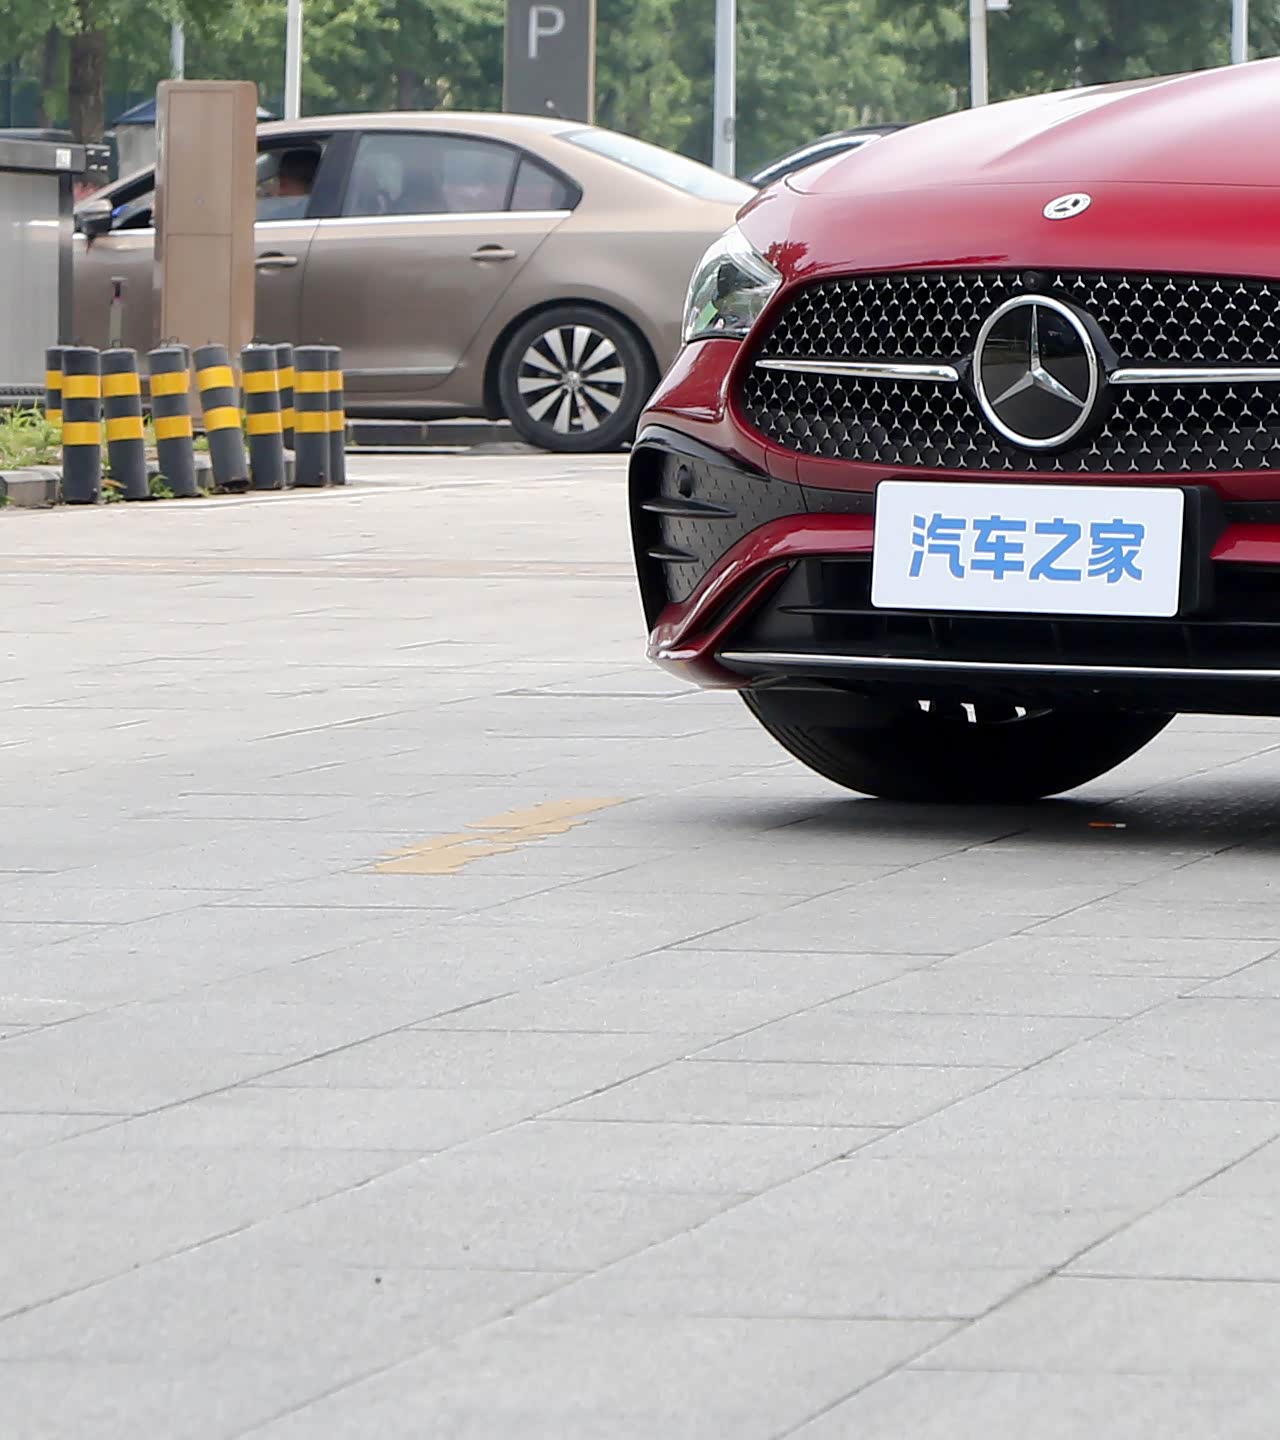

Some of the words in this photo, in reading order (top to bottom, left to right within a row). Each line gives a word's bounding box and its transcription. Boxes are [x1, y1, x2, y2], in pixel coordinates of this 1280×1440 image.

[528, 5, 566, 58] P
[908, 513, 1146, 583] 汽车之家
